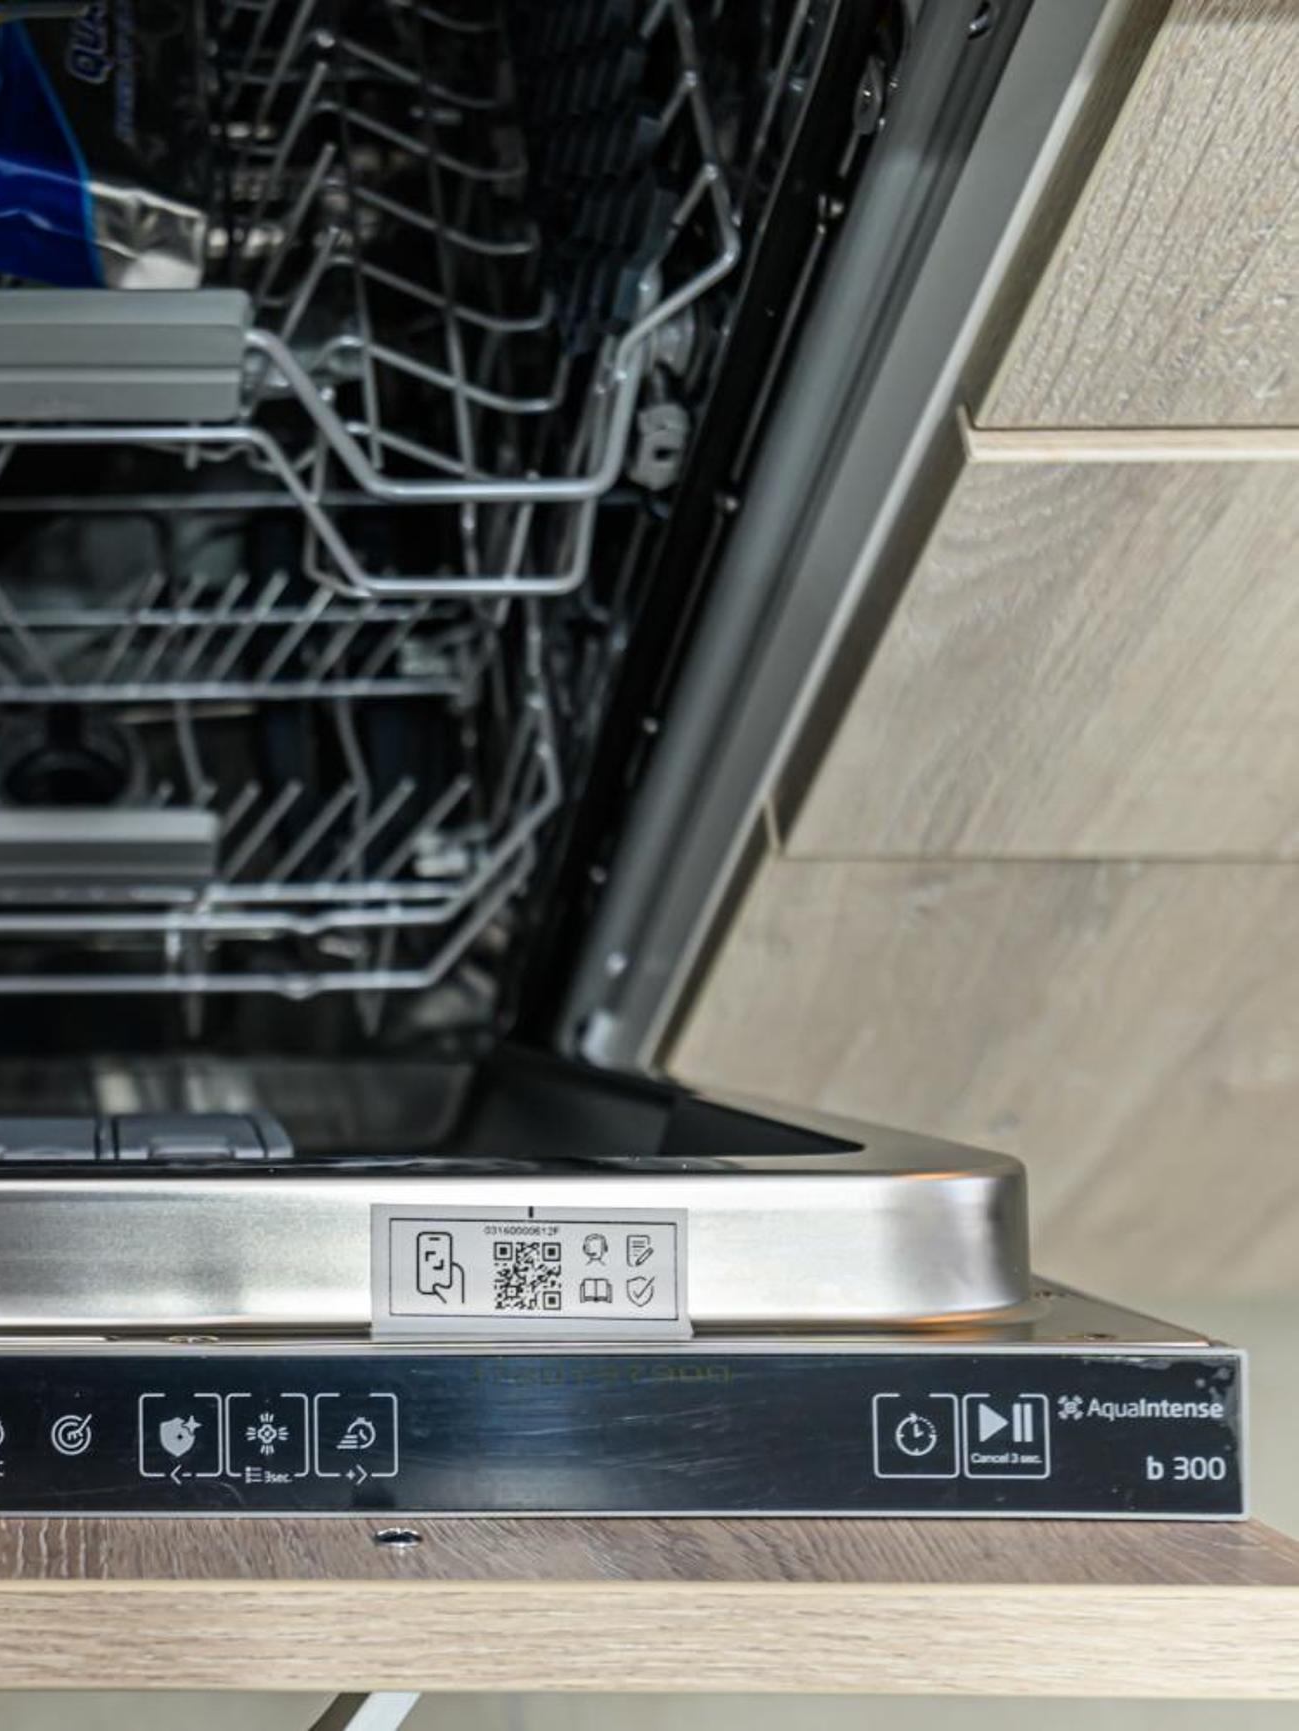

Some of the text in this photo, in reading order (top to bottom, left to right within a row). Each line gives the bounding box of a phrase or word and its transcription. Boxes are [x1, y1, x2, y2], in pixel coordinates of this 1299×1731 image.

[1086, 1399, 1225, 1420] AquaIntense
[1146, 1456, 1226, 1481] b 300
